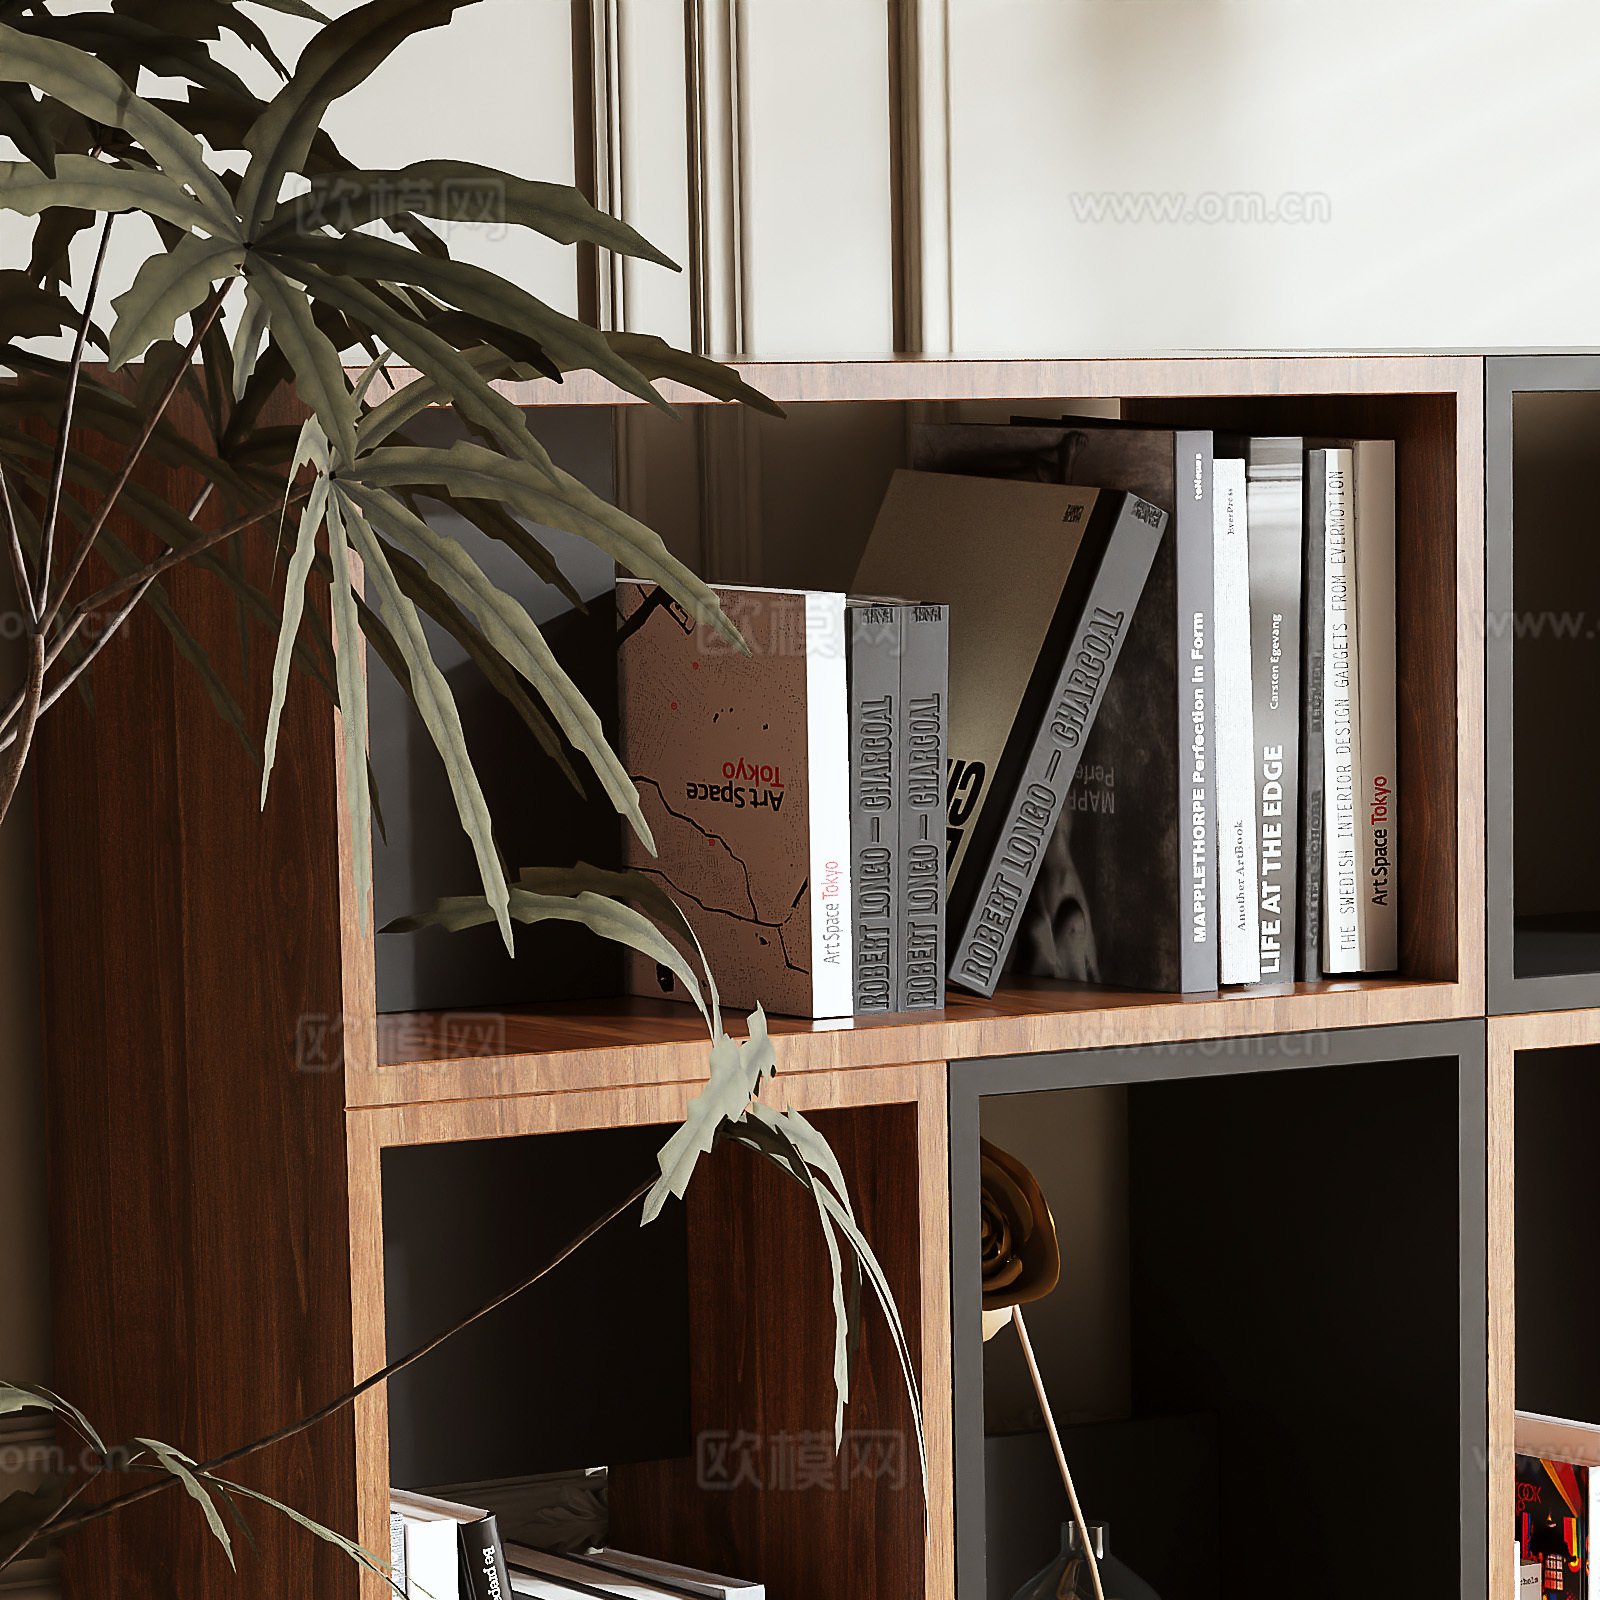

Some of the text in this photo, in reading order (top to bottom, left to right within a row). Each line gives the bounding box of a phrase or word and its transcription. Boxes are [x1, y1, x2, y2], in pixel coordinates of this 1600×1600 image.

[1269, 612, 1283, 711] Carsten Egevang
[1329, 470, 1356, 953] THE SWEDISH INTERIOR DESIGN GADGETS FROM EVERMOTION
[722, 756, 785, 788] Tokyo
[1190, 612, 1208, 944] MAPPLETHORPE Perfection in Form
[1369, 775, 1392, 826] Tokyo
[820, 860, 843, 901] Tokyo
[859, 847, 892, 919] LONGO
[907, 844, 939, 917] LONGO
[961, 872, 1023, 988] ROBERT
[1000, 783, 1057, 878] LONGO
[1259, 744, 1283, 974] LIFE AT THE EDGE
[1235, 879, 1247, 932] Another
[858, 924, 890, 1010] ROBERT
[906, 921, 938, 1009] ROBERT
[482, 1545, 495, 1565] Be
